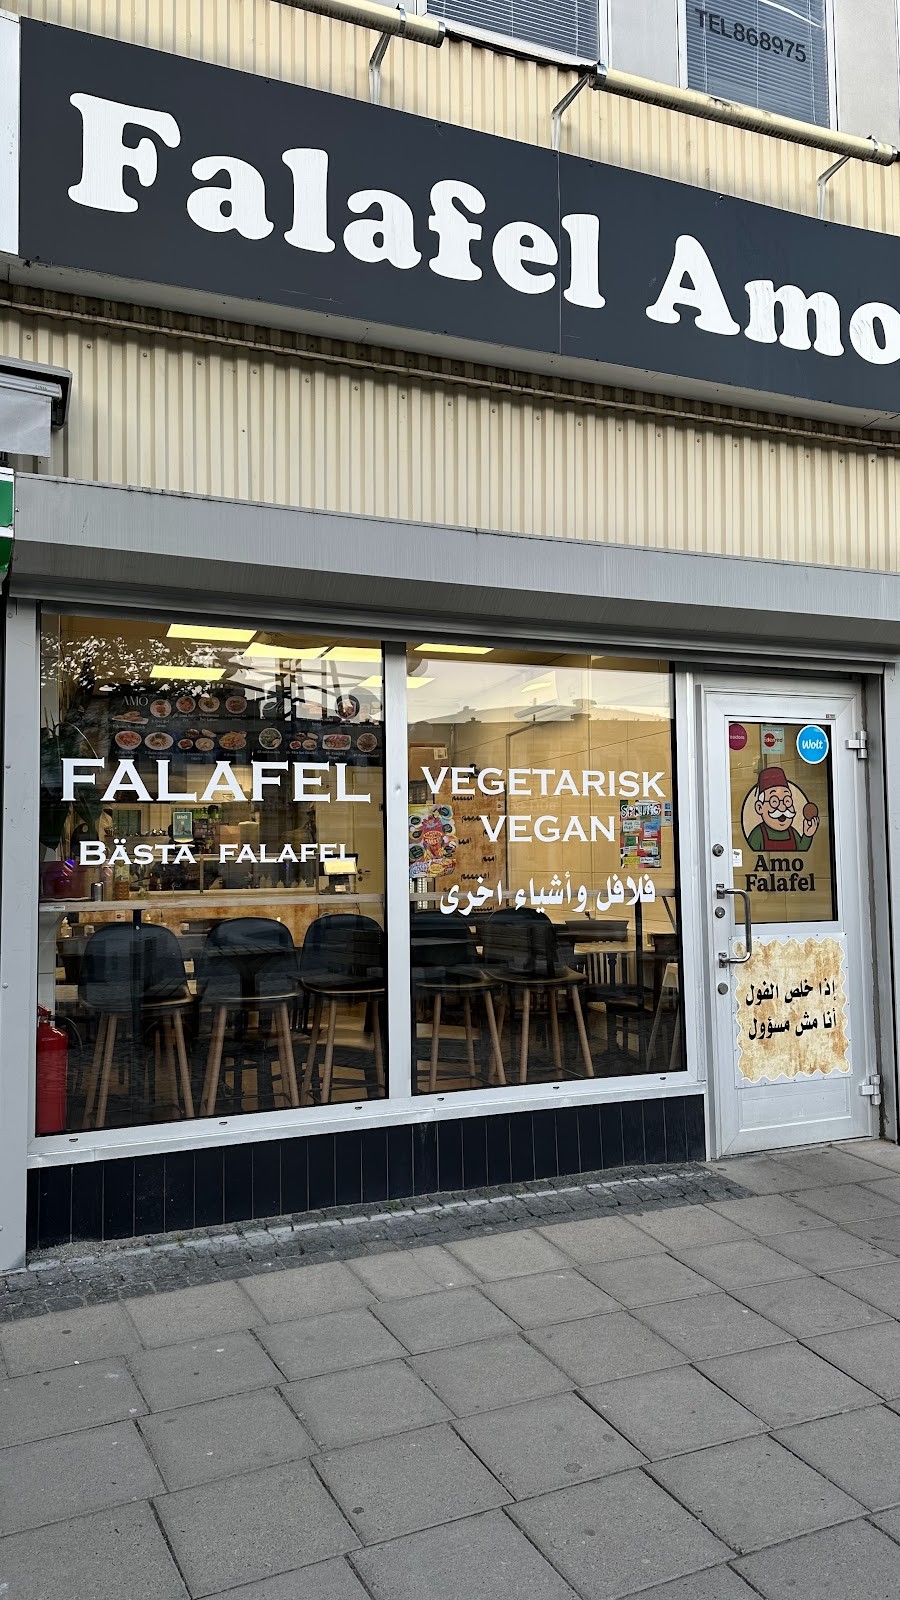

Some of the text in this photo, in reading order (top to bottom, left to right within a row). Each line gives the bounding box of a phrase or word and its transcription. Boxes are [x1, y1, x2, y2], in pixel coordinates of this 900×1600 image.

[694, 8, 807, 62] TEL868975
[67, 91, 900, 366] Falafel Amo
[122, 695, 149, 706] AMO
[802, 739, 824, 750] Wolt
[61, 757, 371, 803] FALAFEL
[421, 766, 666, 798] VEGETARISK
[479, 815, 616, 842] VEGAN
[79, 838, 356, 866] BÄSTA FALAFEL
[753, 854, 804, 872] Amo
[597, 873, 656, 911] فلافل
[744, 873, 815, 892] Falafel
[745, 977, 837, 1006] إذا خلص الفول
[748, 1008, 837, 1040] أنا مش مسؤول
